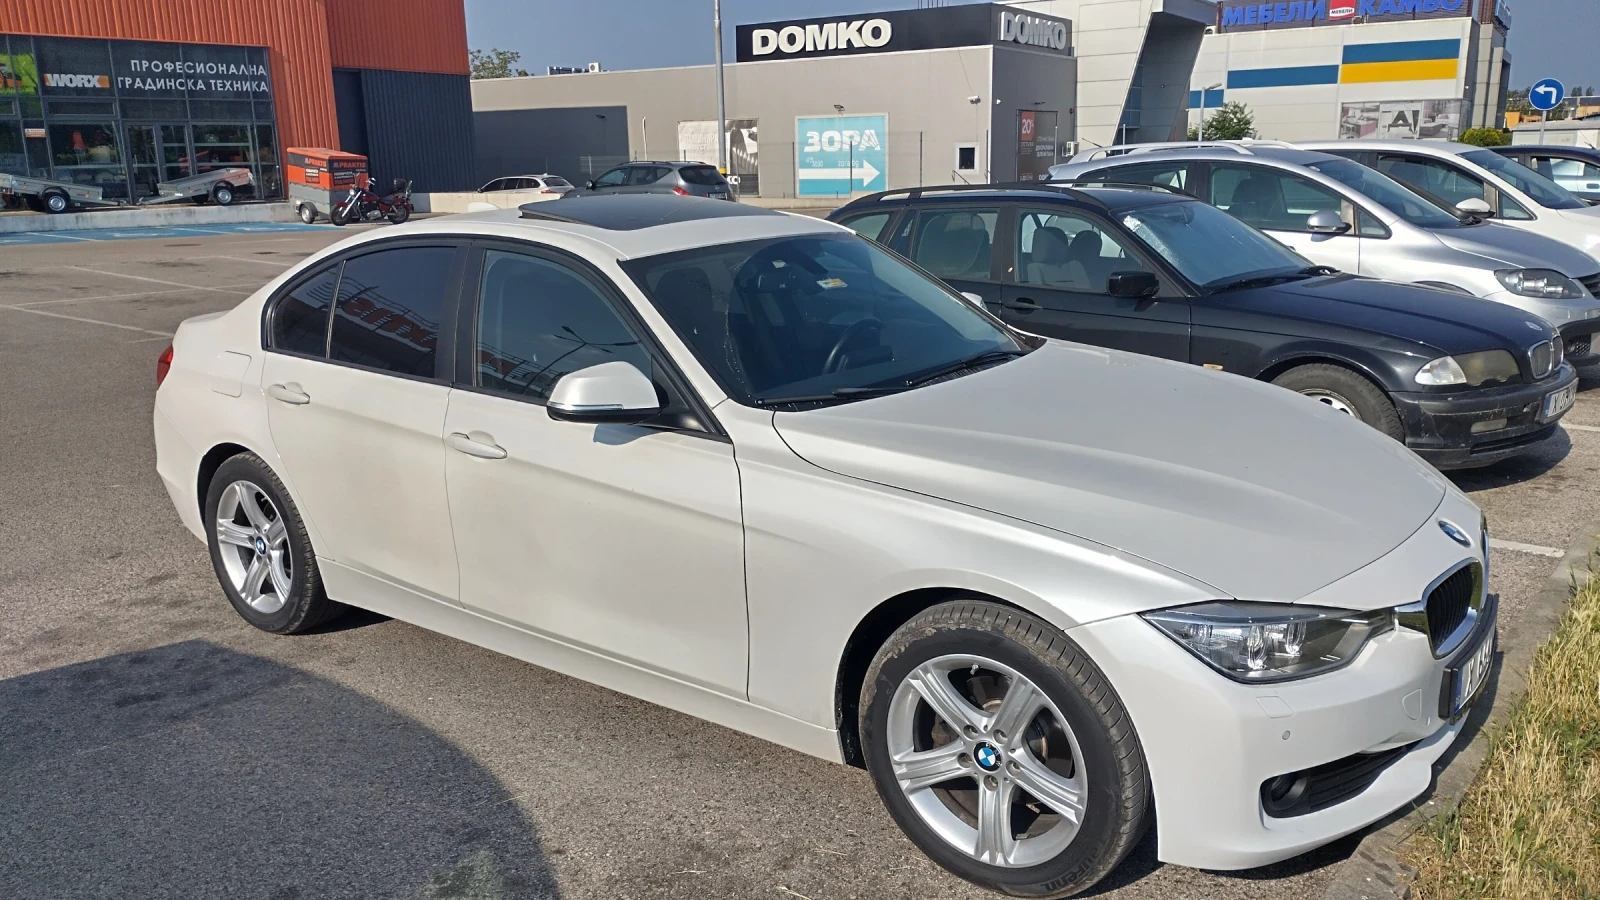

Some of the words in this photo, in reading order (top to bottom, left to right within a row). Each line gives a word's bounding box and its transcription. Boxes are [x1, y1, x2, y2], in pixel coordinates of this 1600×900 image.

[1221, 0, 1325, 26] МЕБЕЛИ
[752, 18, 892, 56] DOMKO
[1000, 12, 1067, 50] DOMKO
[130, 60, 267, 76] ПРОФЕСИОНАЛНА
[46, 73, 102, 88] WORX
[117, 77, 206, 91] ГРАДИНСКА
[210, 79, 269, 92] ТЕХНИКА
[804, 130, 881, 152] ЗОРА
[309, 158, 327, 167] PRAKTIS
[838, 159, 859, 169] zorabg
